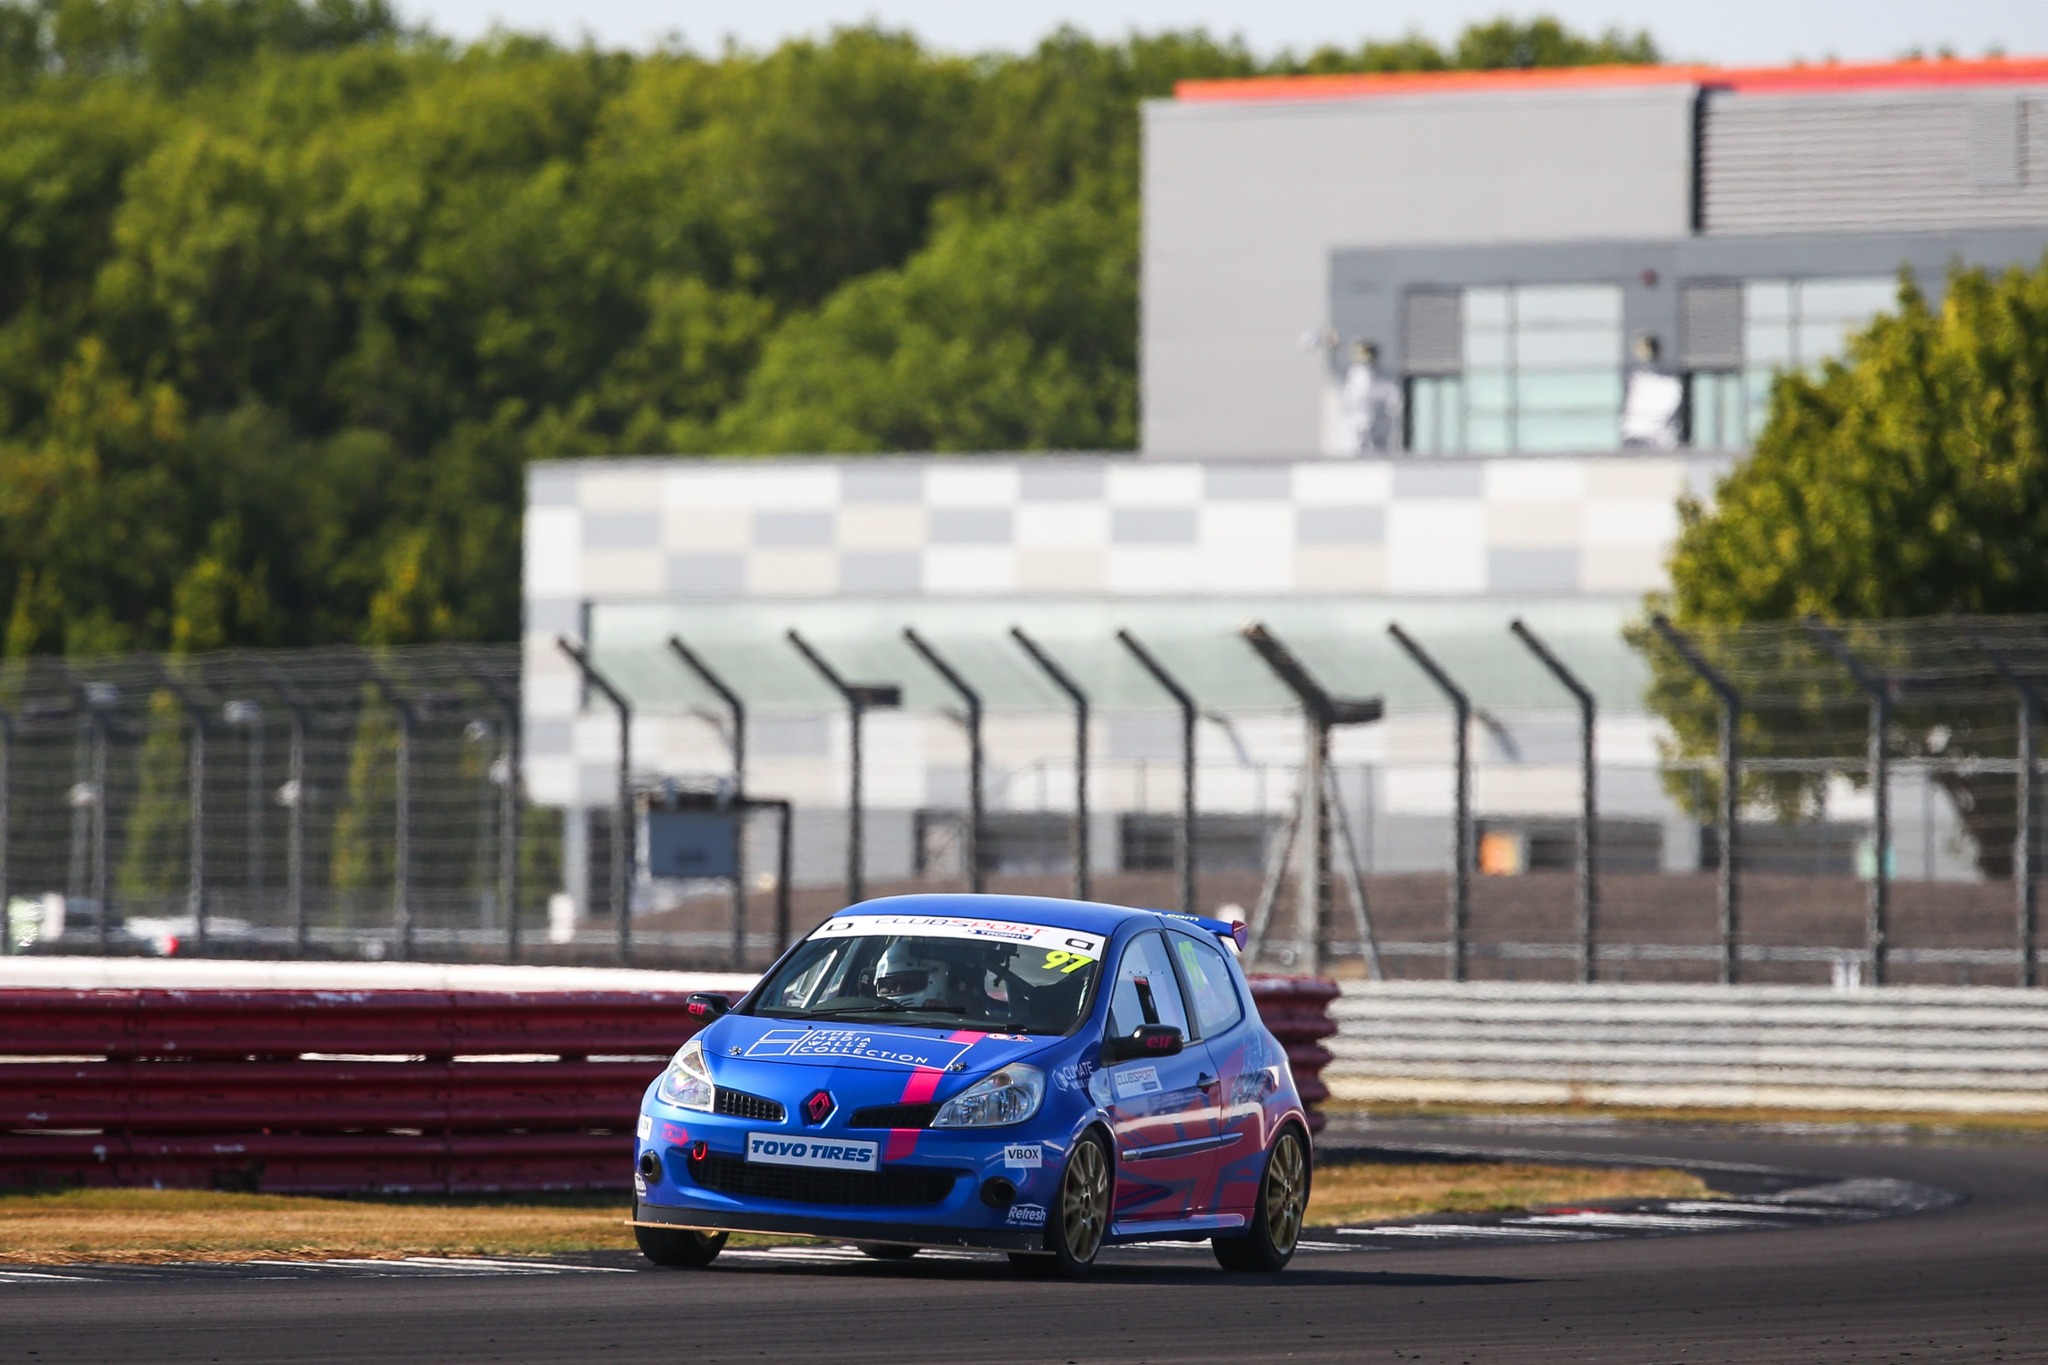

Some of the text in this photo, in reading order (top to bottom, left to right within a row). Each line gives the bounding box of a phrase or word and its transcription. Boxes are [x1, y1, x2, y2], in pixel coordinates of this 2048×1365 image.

[875, 917, 1050, 935] CLUBSPORT
[979, 929, 1030, 940] TROPHY
[1041, 950, 1095, 974] 97
[688, 1003, 708, 1015] elf
[1145, 1034, 1174, 1049] elf
[800, 1046, 928, 1064] COLLECTION
[1062, 1061, 1094, 1080] CLIMATE
[1116, 1069, 1156, 1086] CLUBSPORT
[751, 1139, 873, 1163] TOYO TIRES
[1007, 1149, 1039, 1160] VBOX
[1008, 1206, 1047, 1221] Refresh
